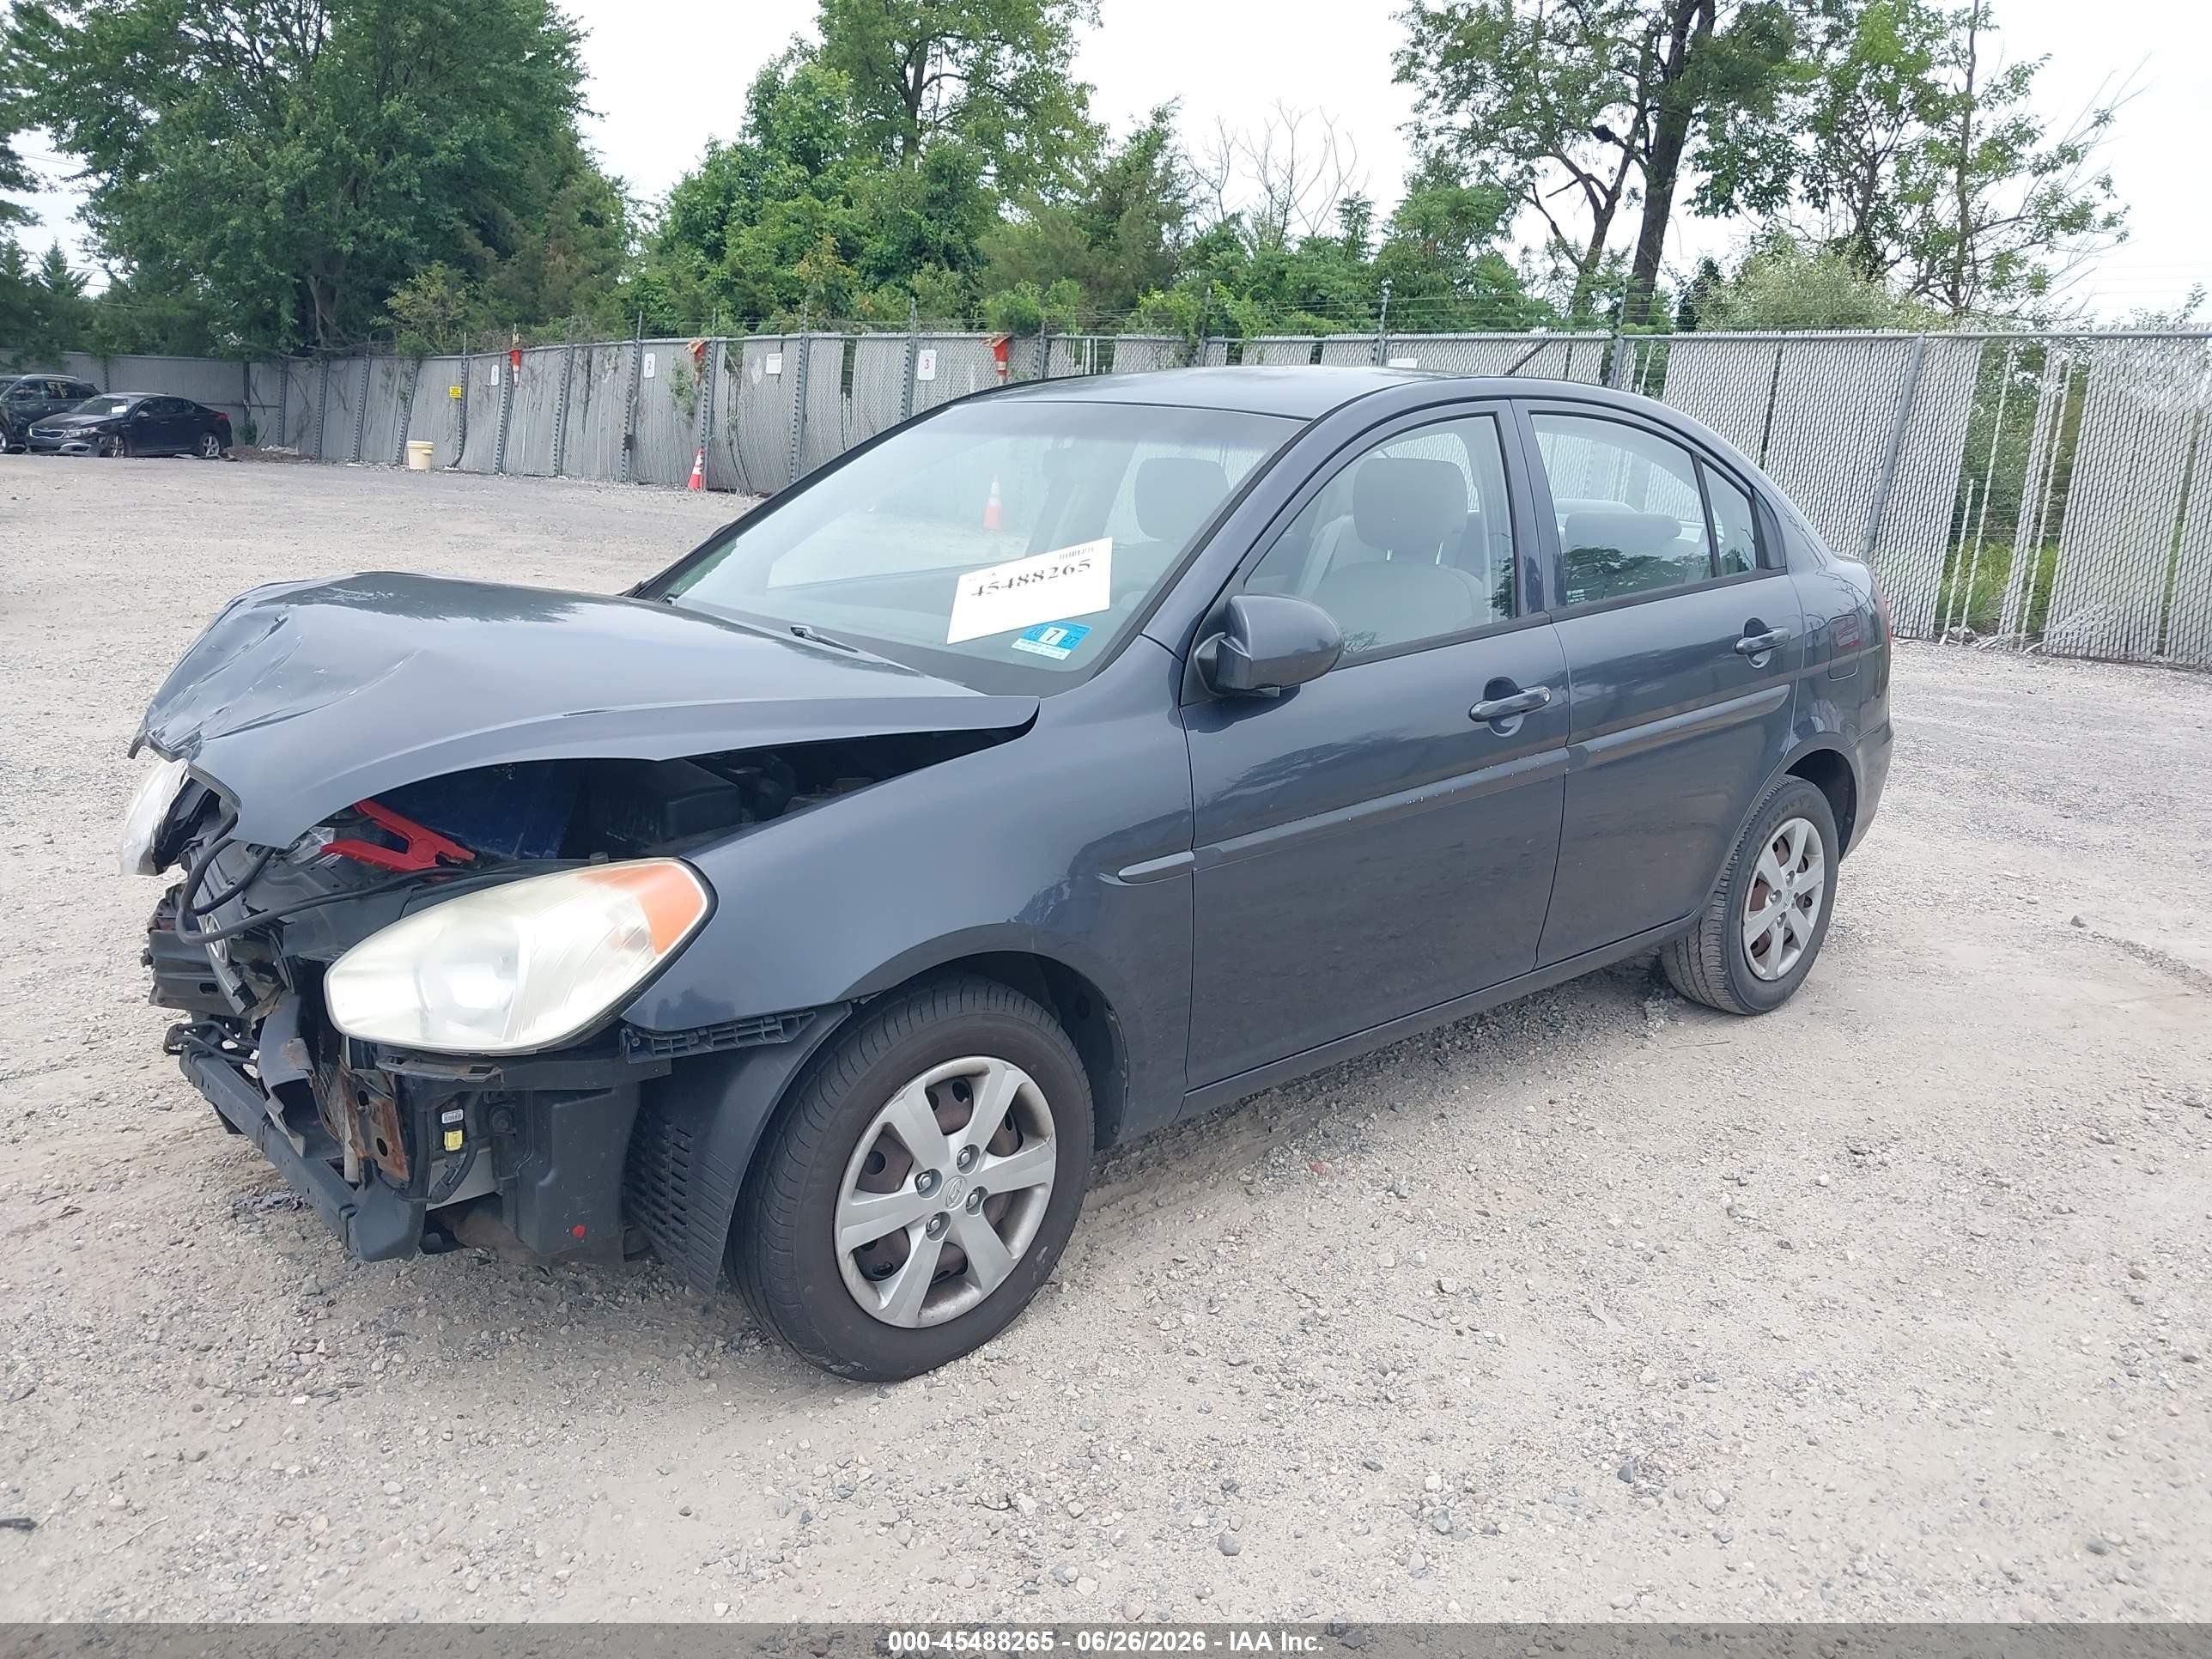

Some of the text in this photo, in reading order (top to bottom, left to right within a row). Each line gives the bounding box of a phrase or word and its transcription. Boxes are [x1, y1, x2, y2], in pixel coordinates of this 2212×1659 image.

[647, 360, 652, 370] 2
[924, 358, 930, 370] 3
[971, 558, 1091, 597] 45488265
[1046, 629, 1061, 641] 7
